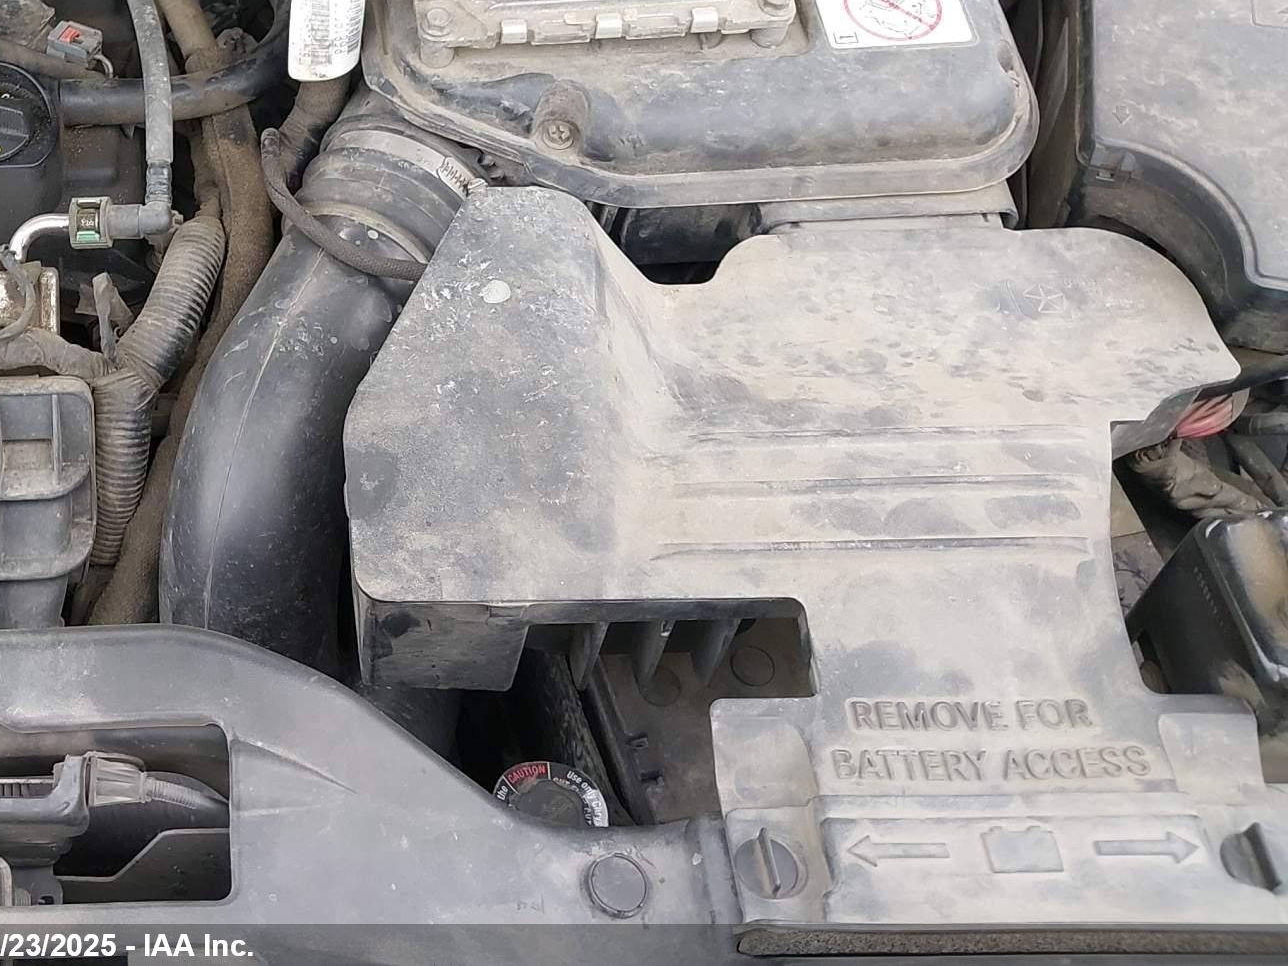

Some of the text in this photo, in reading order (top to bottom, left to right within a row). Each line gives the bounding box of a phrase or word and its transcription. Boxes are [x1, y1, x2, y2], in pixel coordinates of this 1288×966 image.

[850, 698, 1093, 731] REMOVE FOR
[832, 745, 1152, 782] BATTERY ACCESS
[508, 765, 547, 784] CAUTION
[566, 770, 582, 783] Use
[496, 785, 509, 801] the
